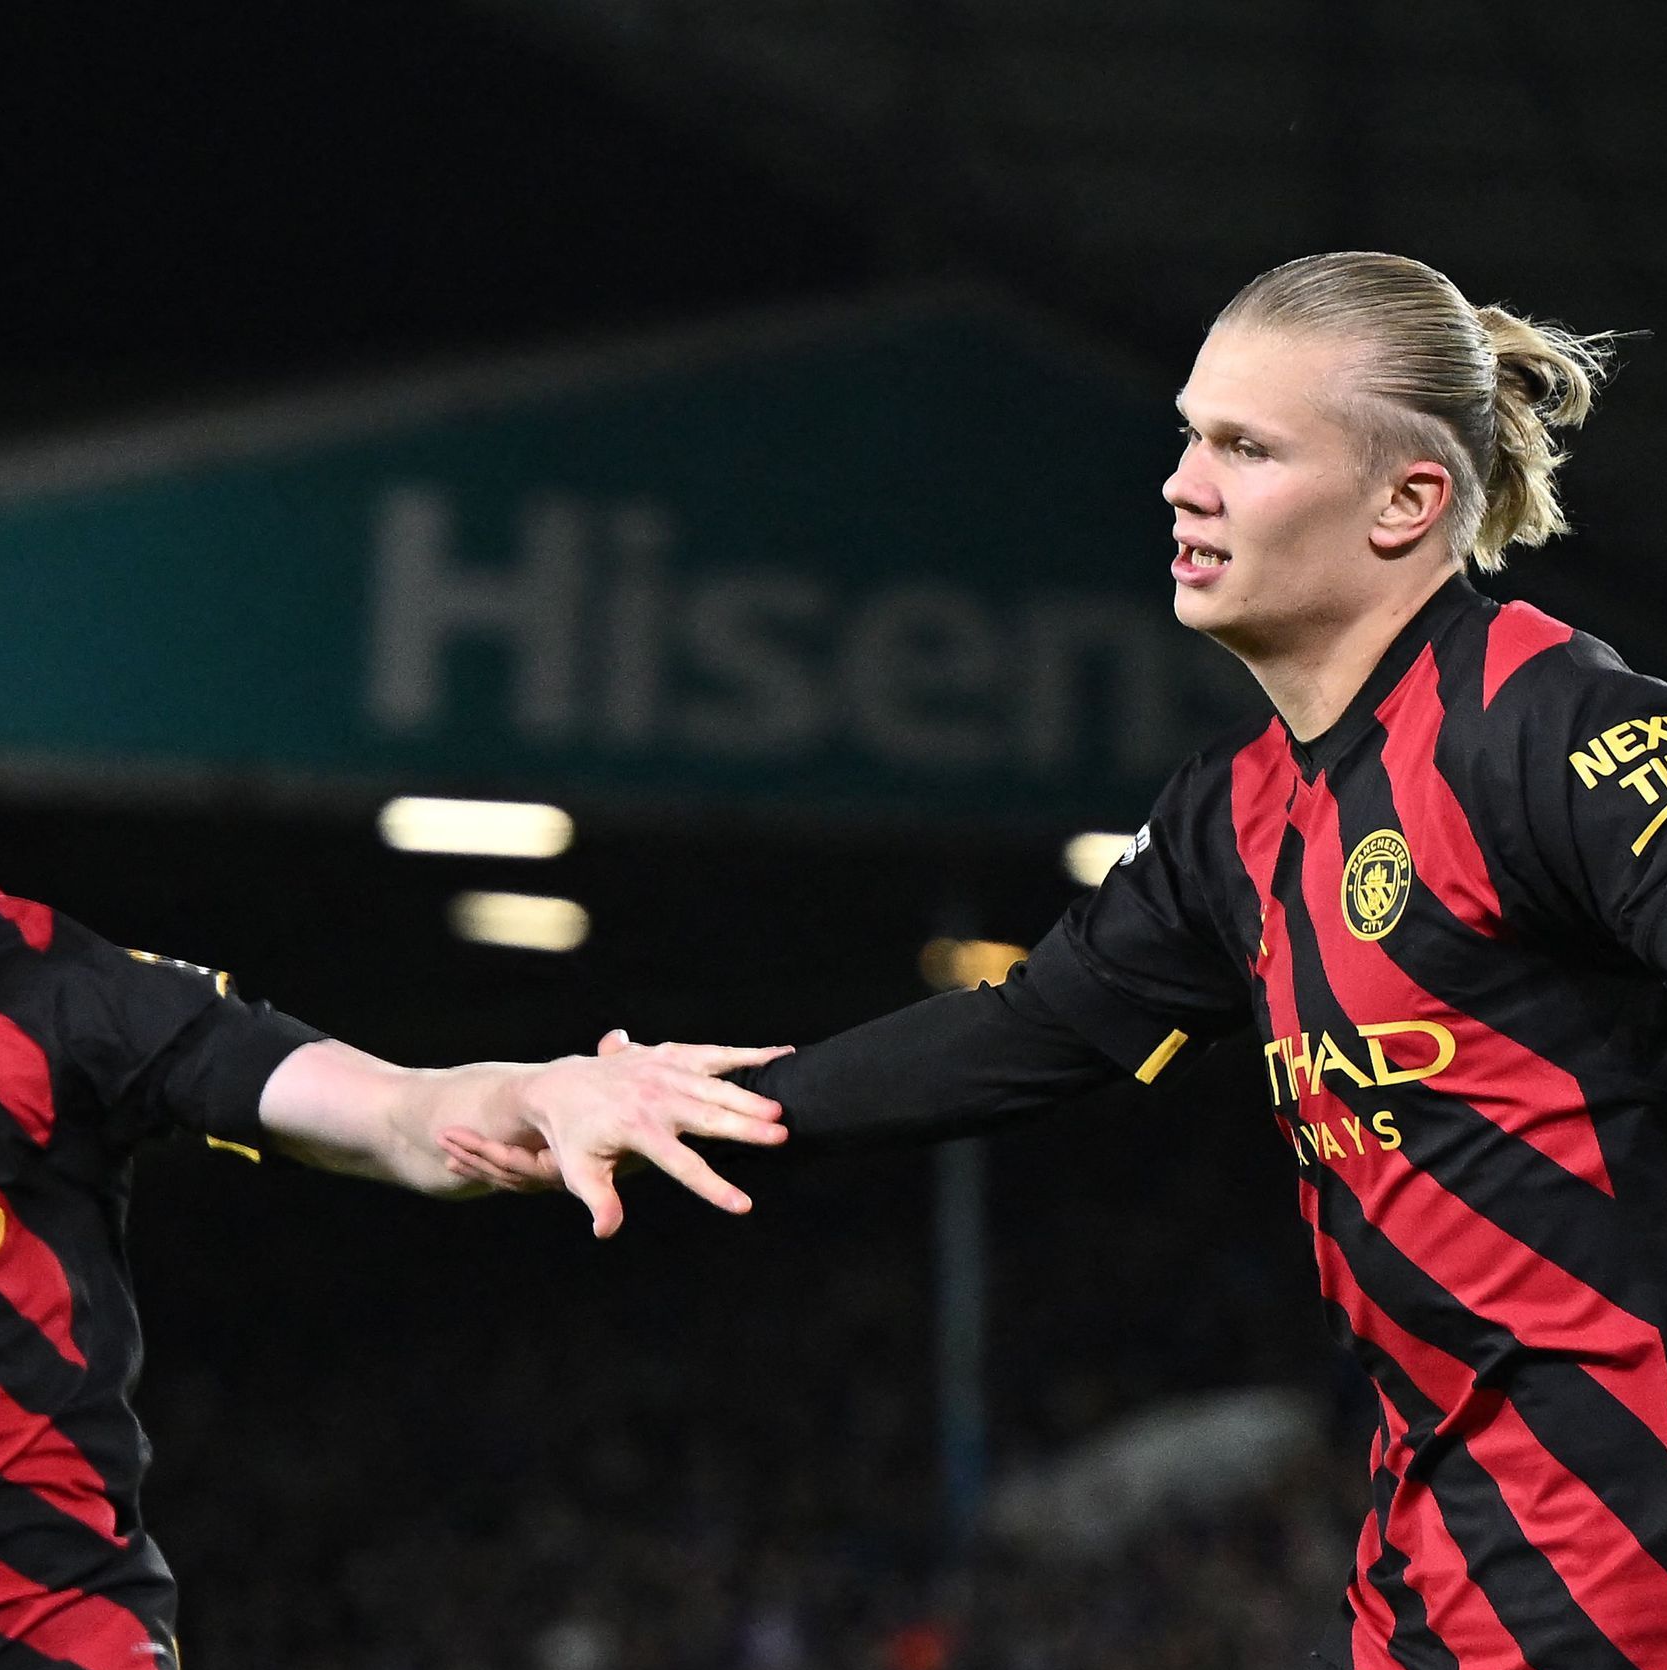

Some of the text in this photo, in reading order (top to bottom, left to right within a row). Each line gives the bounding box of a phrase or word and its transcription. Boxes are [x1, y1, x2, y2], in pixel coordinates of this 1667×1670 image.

[368, 486, 1190, 768] Hisen
[1350, 837, 1408, 875] MANCHESTER
[1361, 919, 1385, 933] CITY
[1264, 1020, 1456, 1106] TIHAD
